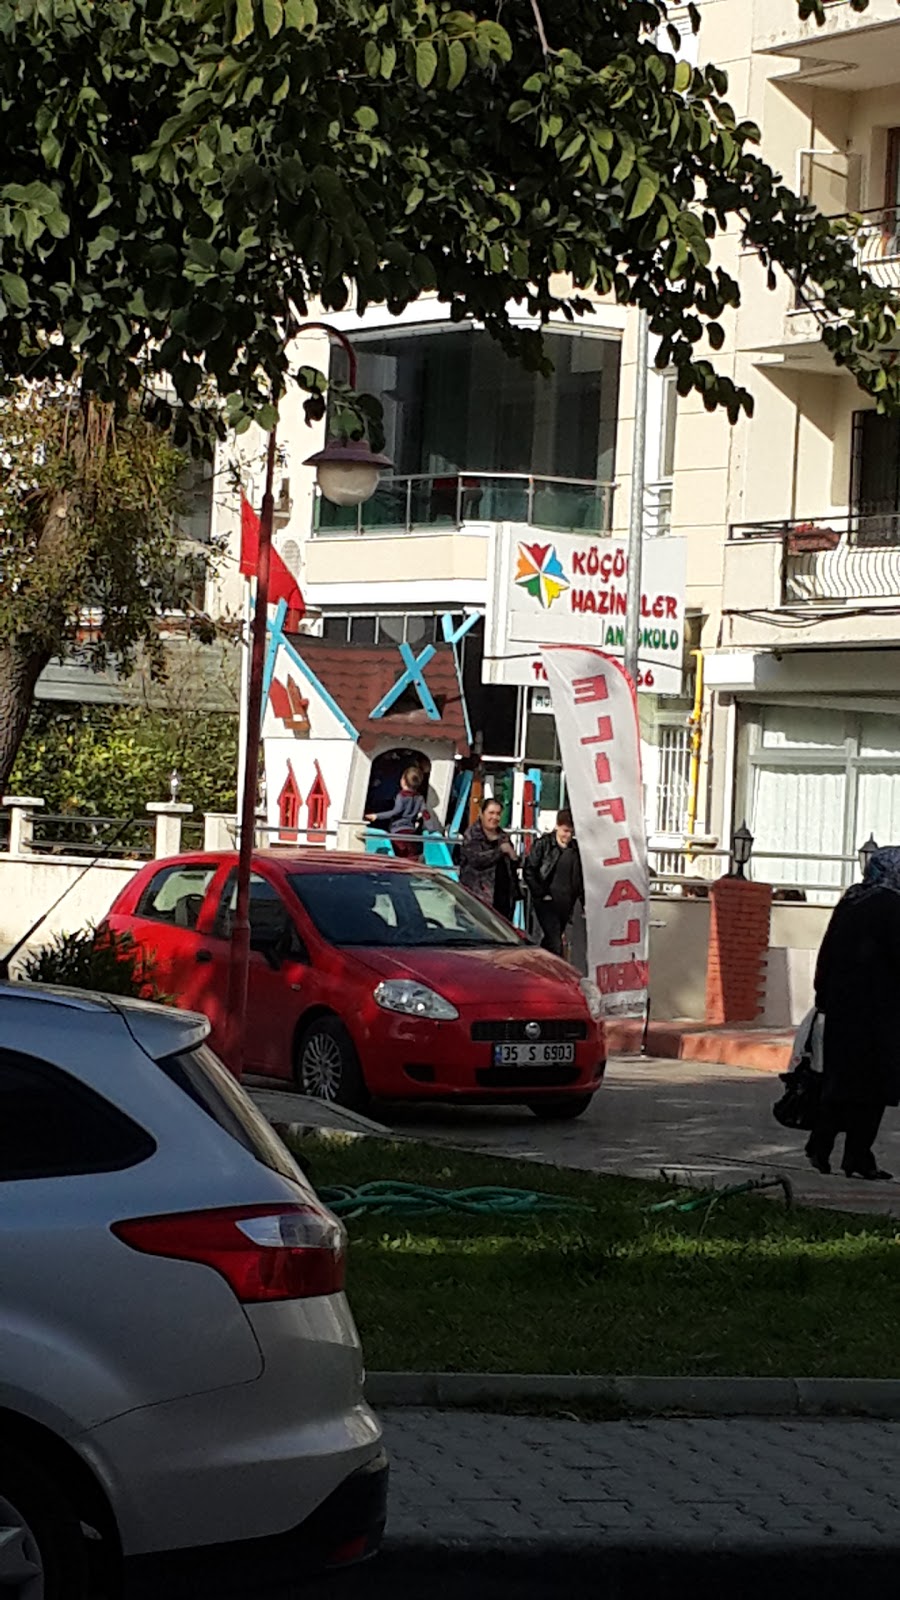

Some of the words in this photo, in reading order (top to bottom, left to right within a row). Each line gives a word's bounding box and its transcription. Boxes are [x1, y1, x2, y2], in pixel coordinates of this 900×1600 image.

[572, 545, 628, 583] KÜÇÜ
[571, 585, 677, 619] HAZİNLER
[504, 1046, 518, 1061] 35
[529, 1046, 537, 1061] S
